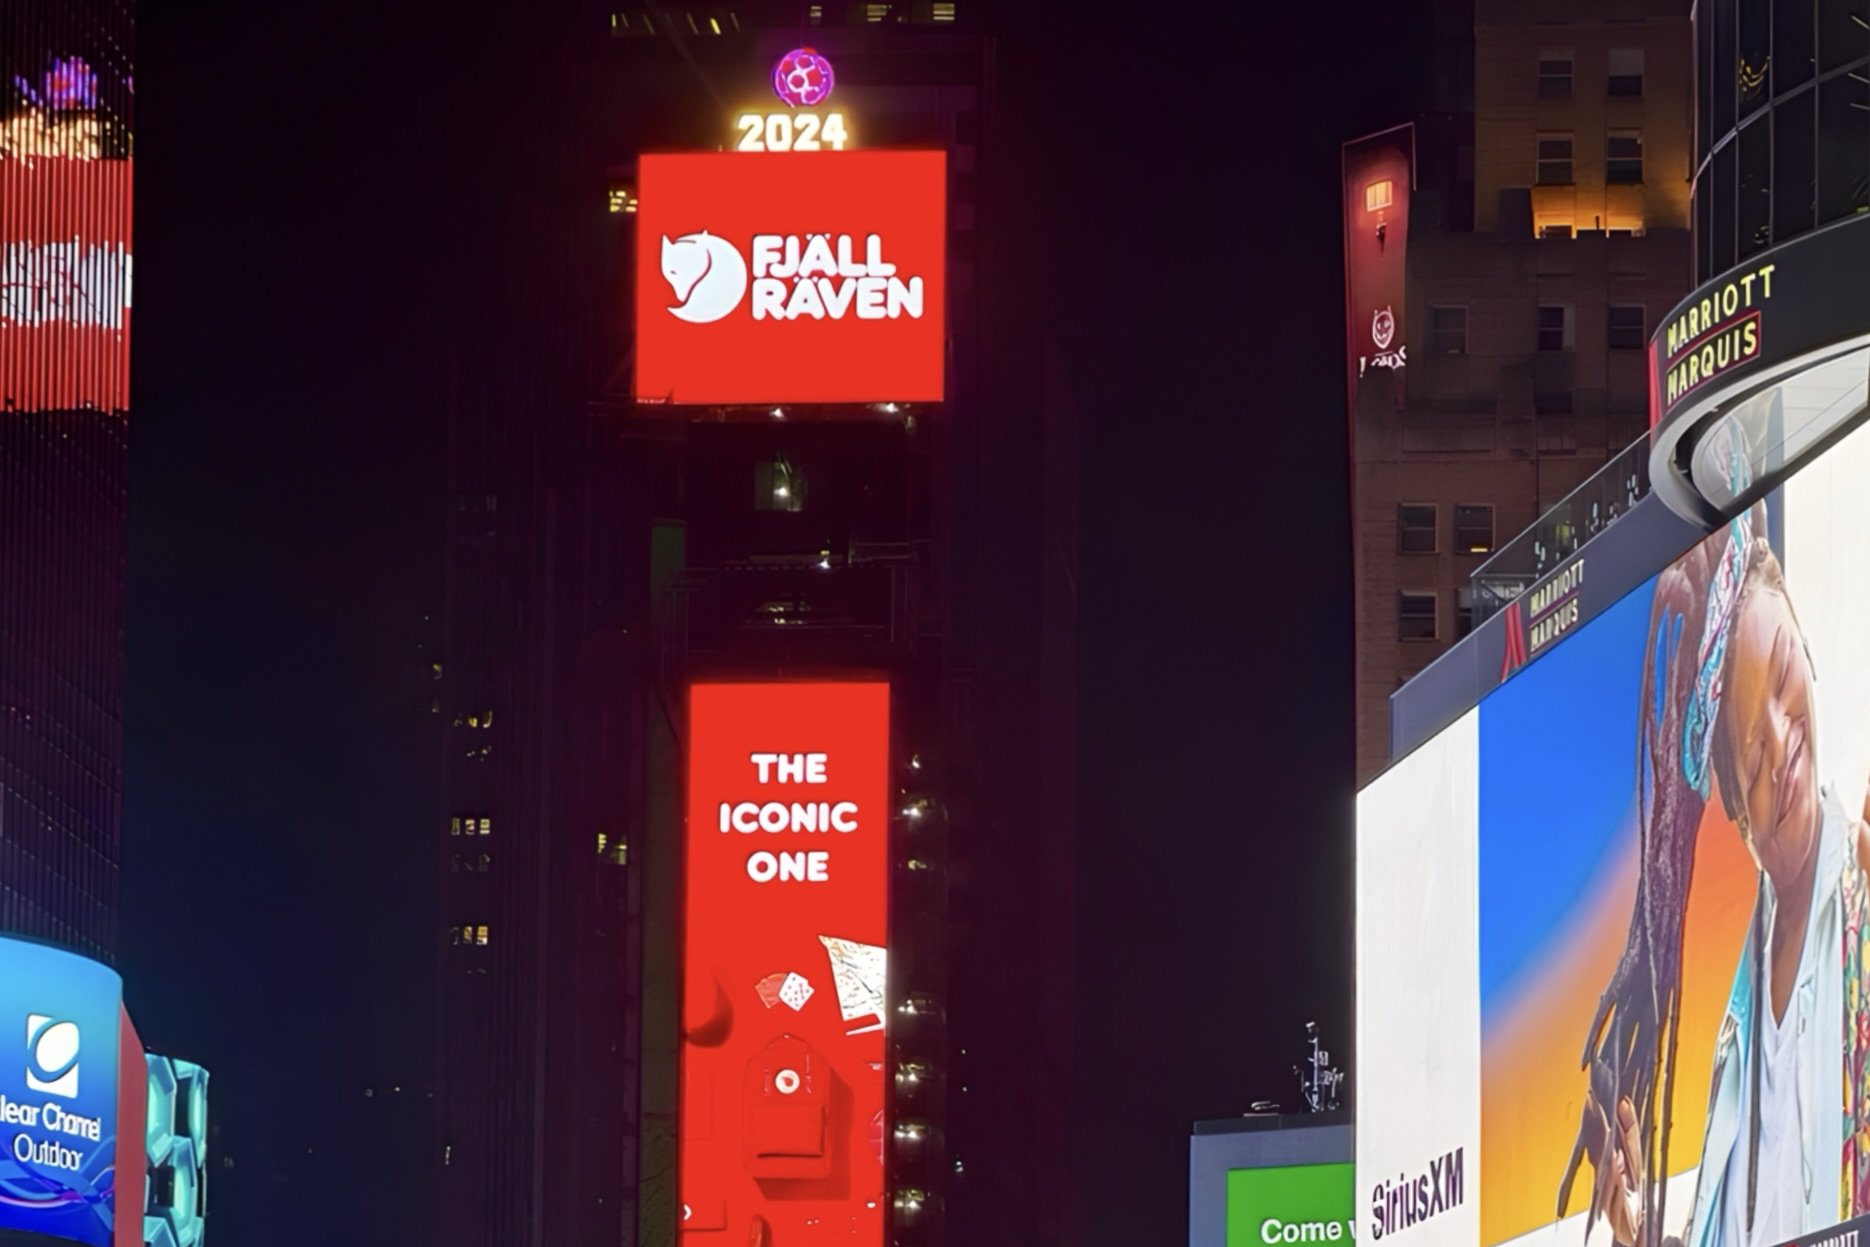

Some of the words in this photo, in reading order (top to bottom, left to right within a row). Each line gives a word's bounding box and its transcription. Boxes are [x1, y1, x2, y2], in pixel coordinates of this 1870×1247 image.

[737, 113, 848, 152] 2024
[752, 233, 896, 278] FJÄLL
[752, 276, 923, 321] RÄVEN
[1667, 264, 1775, 358] MARRIOTT
[1667, 321, 1757, 406] MARQUIS
[750, 753, 828, 784] THE
[719, 801, 859, 833] ICONIC
[746, 850, 830, 883] ONE
[1371, 1147, 1463, 1240] SiriusXM
[1260, 1218, 1343, 1244] Come
